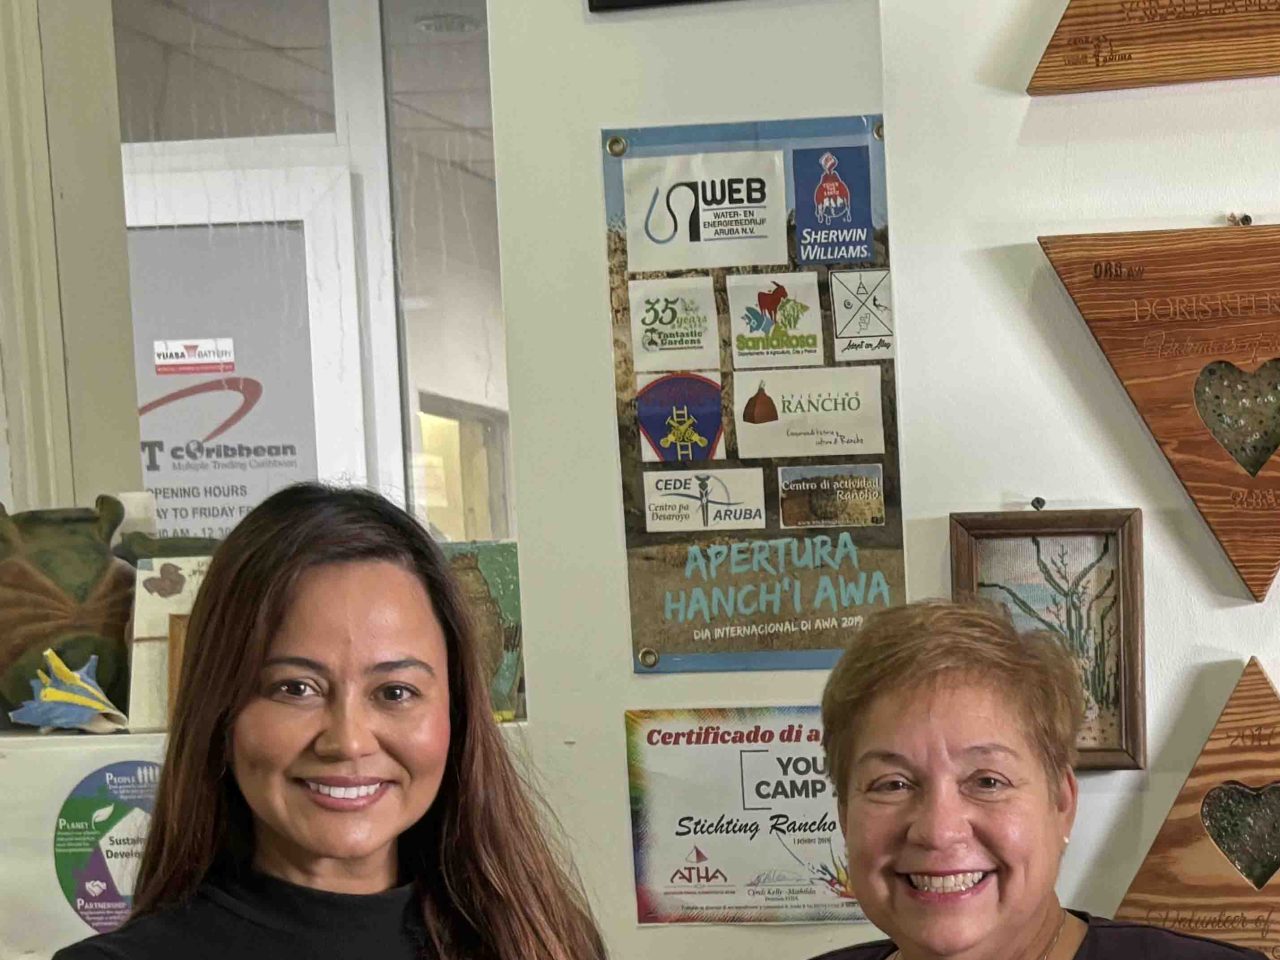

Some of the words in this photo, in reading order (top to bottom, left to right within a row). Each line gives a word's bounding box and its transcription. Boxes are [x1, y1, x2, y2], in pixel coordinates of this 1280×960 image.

[701, 178, 767, 207] WEB
[743, 210, 755, 219] EN
[713, 228, 740, 237] ARUBA
[801, 227, 868, 245] SHERWIN
[800, 245, 868, 261] WILLIAMS
[641, 296, 680, 326] 35
[781, 397, 861, 413] RANCHO
[204, 485, 248, 498] HOURS
[655, 478, 692, 491] CEDE
[781, 480, 816, 491] Centro
[820, 479, 830, 490] di
[833, 477, 880, 490] actividad
[172, 507, 189, 519] TO
[192, 506, 235, 519] FRIDAY
[648, 504, 677, 513] Centro
[679, 504, 689, 514] pa
[713, 508, 762, 521] ARUBA
[684, 532, 859, 582] APERTURA
[664, 577, 802, 624] HANCH'I
[813, 570, 891, 613] AWA
[694, 627, 711, 640] DIA
[714, 624, 799, 639] INTERNACIONAL
[800, 620, 812, 632] DI
[814, 618, 838, 630] AWA
[646, 725, 775, 746] Certificado
[779, 724, 804, 743] di
[755, 779, 827, 800] CAMP
[675, 814, 761, 841] Stichting
[769, 812, 837, 835] Rancho
[669, 866, 728, 884] ATHA
[1254, 906, 1275, 938] of
